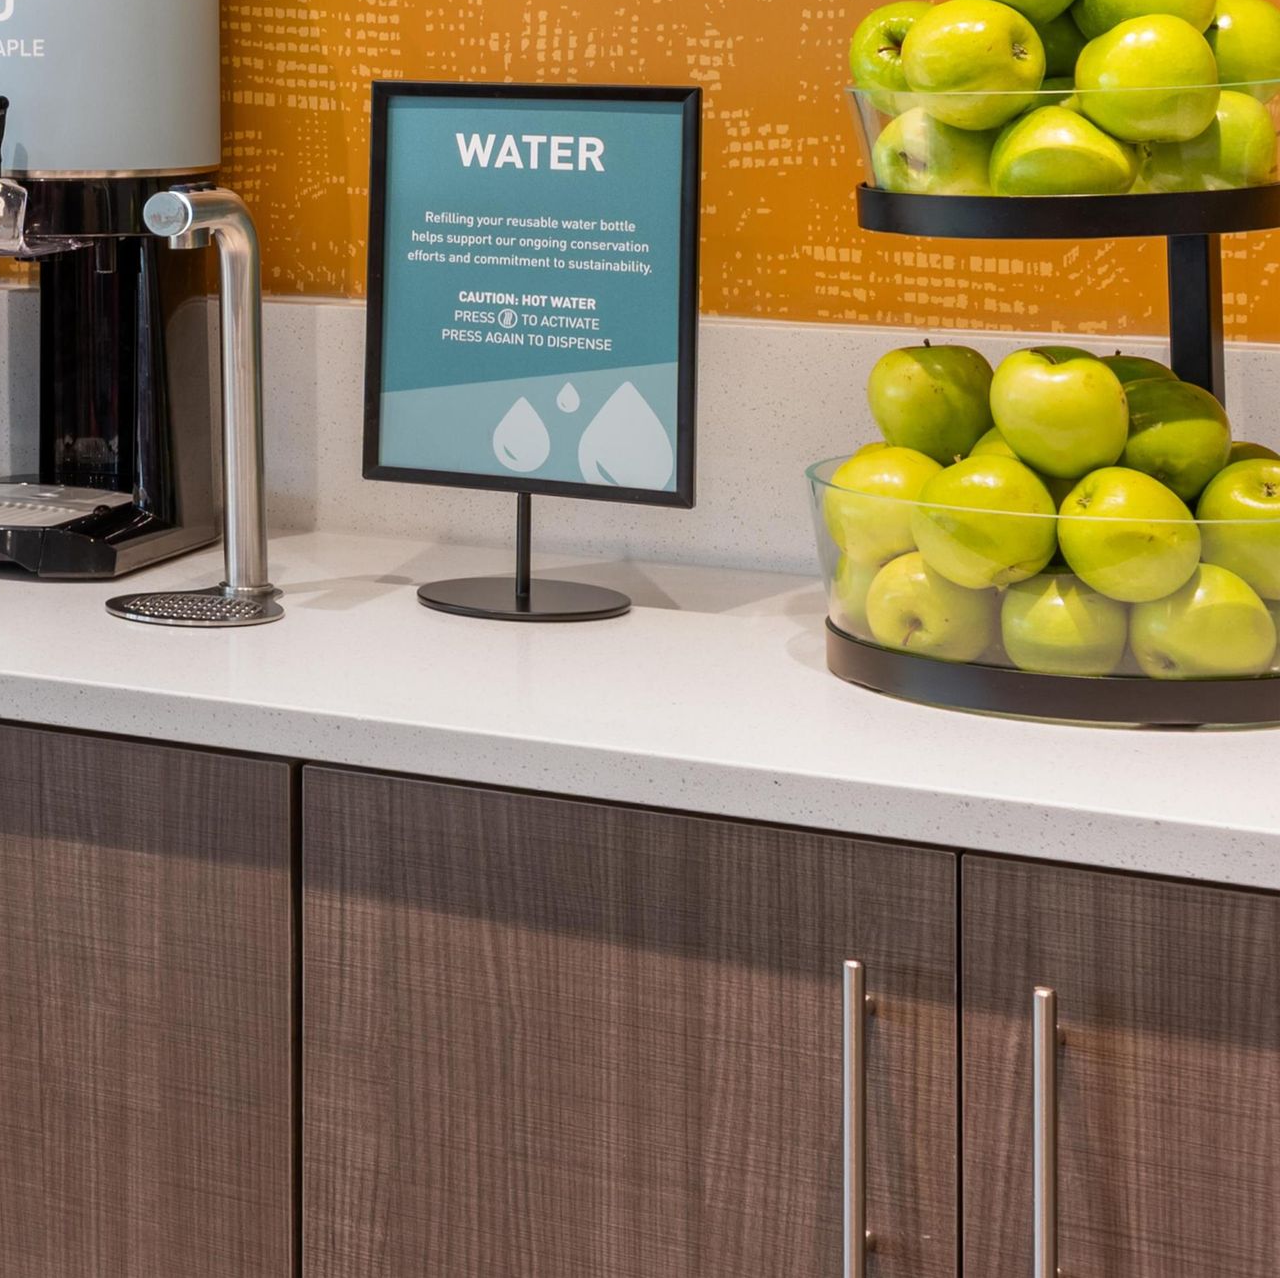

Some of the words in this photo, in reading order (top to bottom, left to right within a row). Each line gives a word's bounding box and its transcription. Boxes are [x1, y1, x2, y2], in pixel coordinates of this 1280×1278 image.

[456, 133, 604, 171] WATER
[426, 212, 473, 227] Refilling
[477, 217, 503, 227] your
[507, 217, 558, 228] reusable
[562, 220, 596, 229] water
[601, 220, 635, 232] bottle
[412, 230, 443, 244] helps
[447, 235, 491, 246] support
[496, 237, 516, 245] our
[519, 239, 566, 251] ongoing
[571, 241, 648, 252] conservation
[408, 251, 445, 262] efforts
[449, 253, 470, 263] and
[474, 255, 549, 267] commitment
[554, 258, 565, 268] to
[569, 260, 652, 275] sustainability.
[459, 291, 518, 305] CAUTION:
[522, 295, 547, 306] HOT
[551, 297, 595, 309] WATER
[455, 310, 495, 323] PRESS
[522, 314, 537, 325] TO
[541, 316, 599, 330] ACTIVATE
[442, 329, 482, 342] PRESS
[486, 332, 523, 344] AGAIN
[528, 334, 543, 346] TO
[548, 336, 611, 350] DISPENSE
